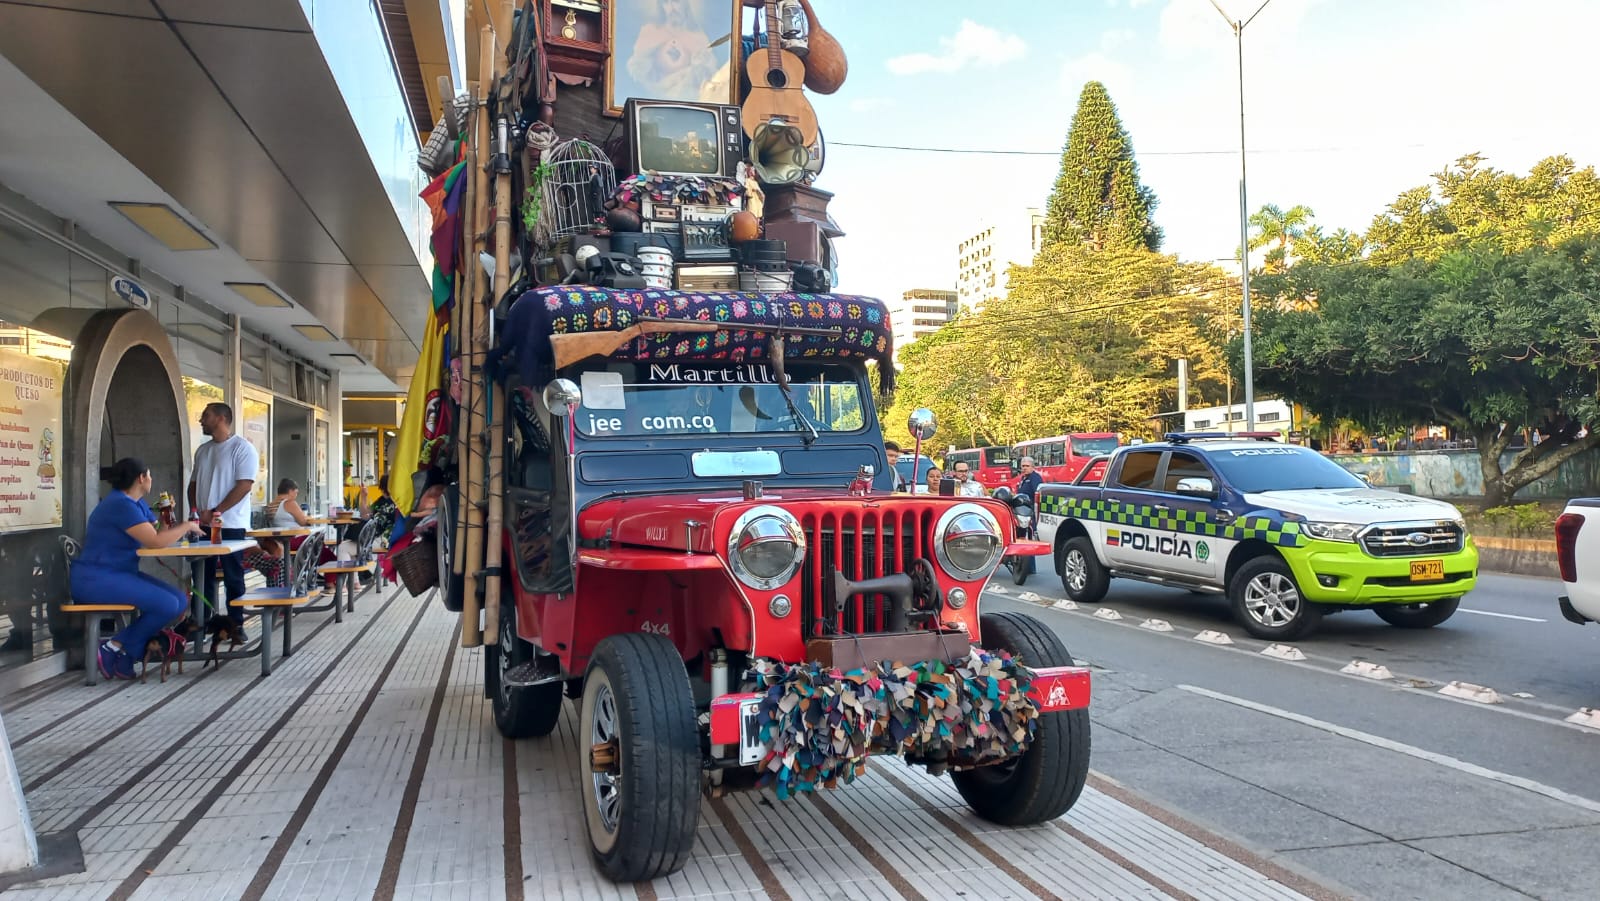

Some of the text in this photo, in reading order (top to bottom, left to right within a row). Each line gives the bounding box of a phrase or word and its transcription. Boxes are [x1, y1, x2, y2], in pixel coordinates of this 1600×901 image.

[45, 377, 54, 390] DE
[15, 385, 39, 401] QUESO
[589, 414, 715, 435] jee com.co
[1120, 531, 1193, 559] POLICÍA
